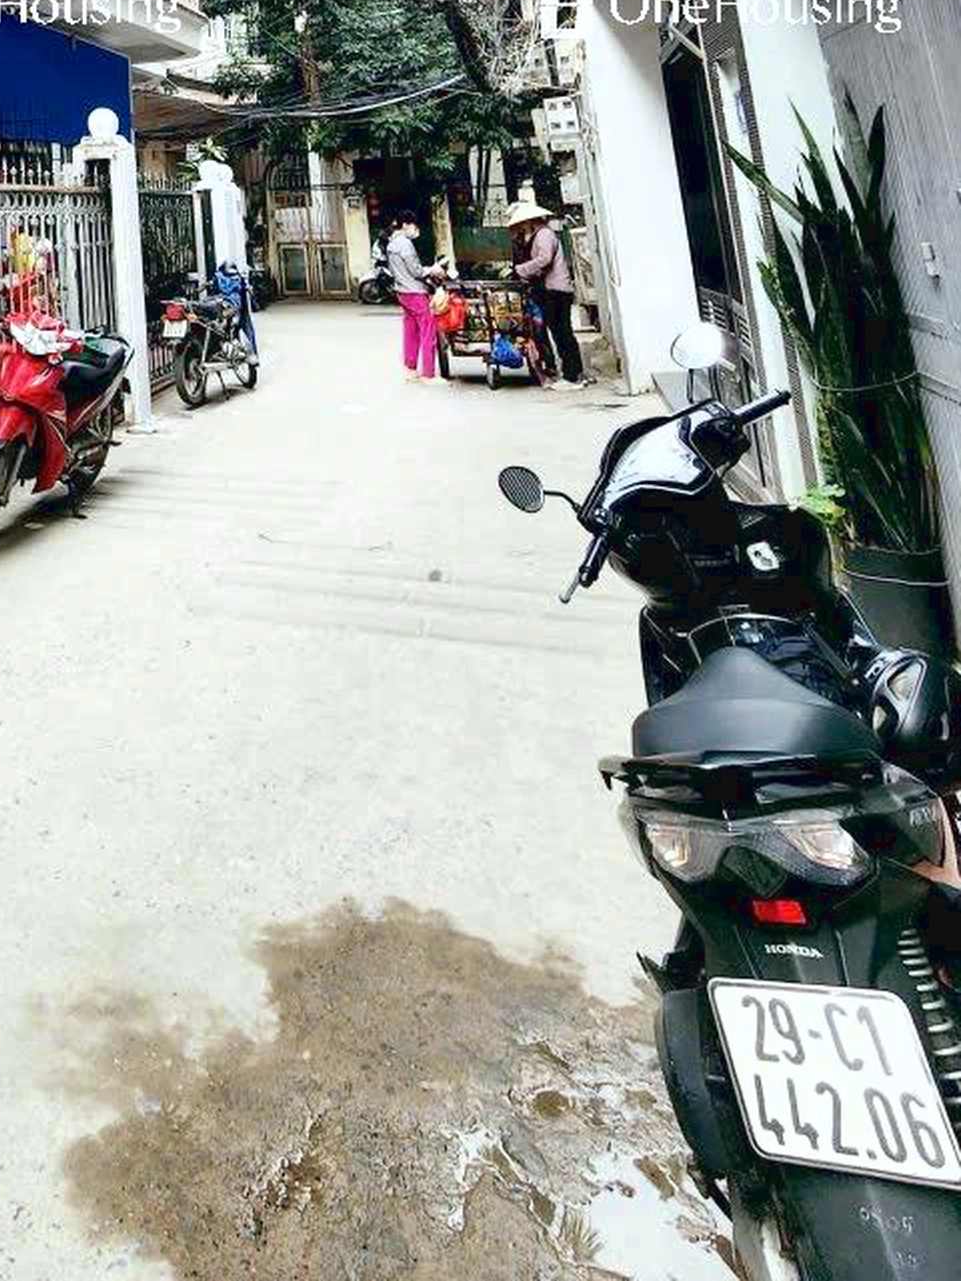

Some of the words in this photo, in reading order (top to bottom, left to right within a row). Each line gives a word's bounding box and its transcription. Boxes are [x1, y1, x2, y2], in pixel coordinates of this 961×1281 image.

[764, 943, 824, 958] HONDA
[742, 995, 893, 1076] 29-C1
[753, 1074, 946, 1170] 442.06
